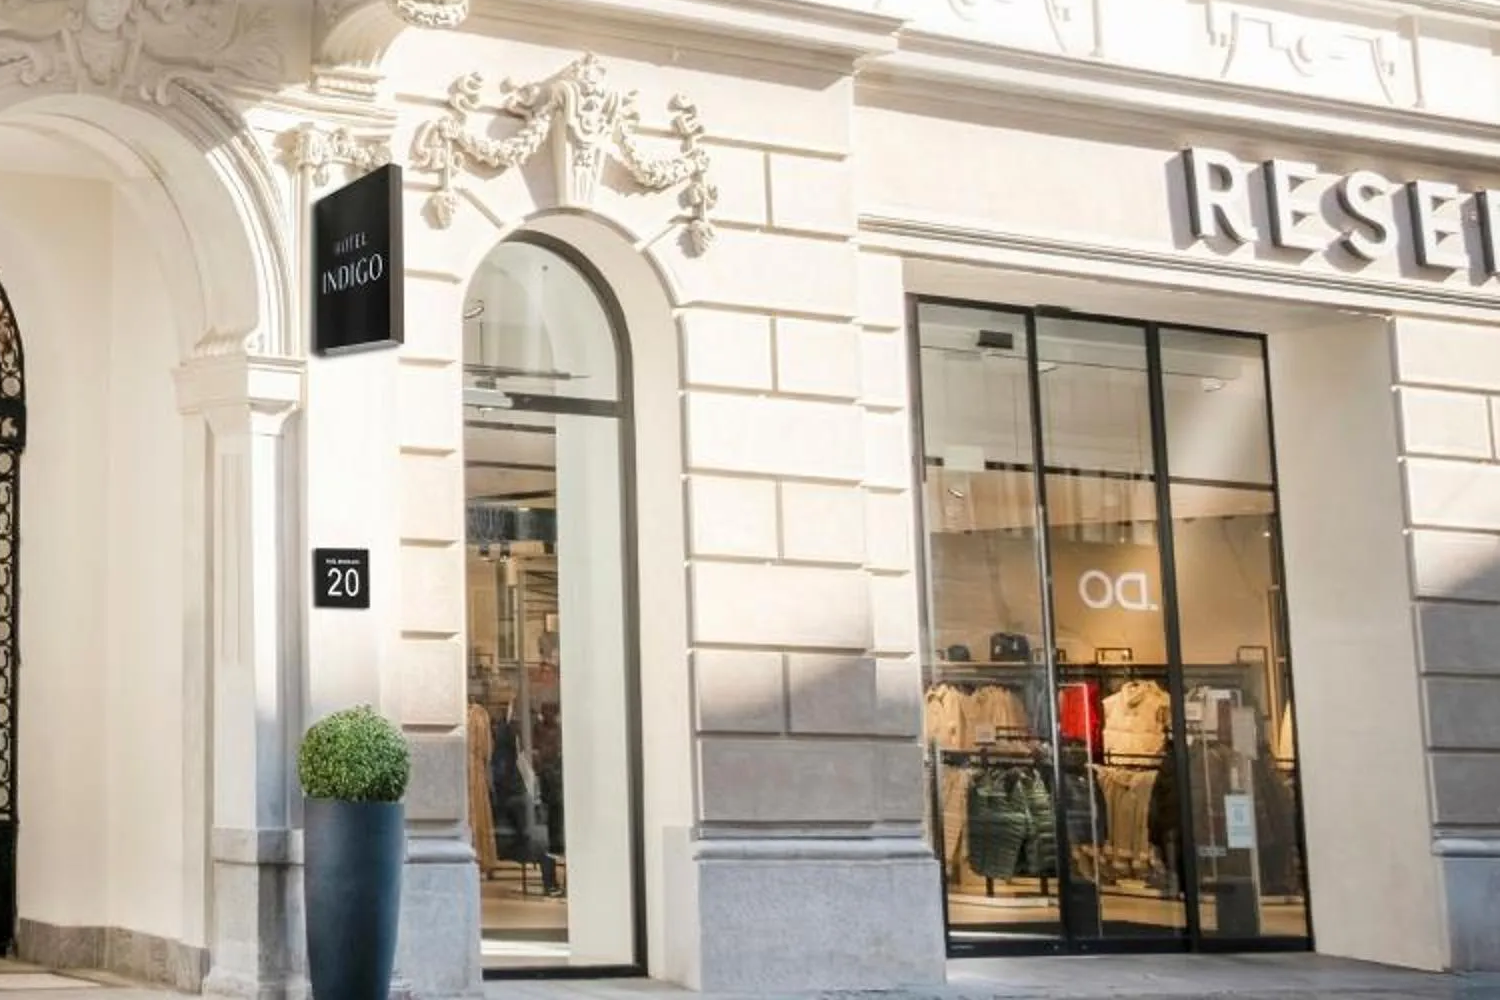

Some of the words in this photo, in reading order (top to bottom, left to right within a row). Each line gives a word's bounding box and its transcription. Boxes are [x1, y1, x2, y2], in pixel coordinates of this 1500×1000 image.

[1183, 147, 1500, 275] RESE
[323, 253, 383, 295] INDIGO
[327, 567, 359, 597] 20
